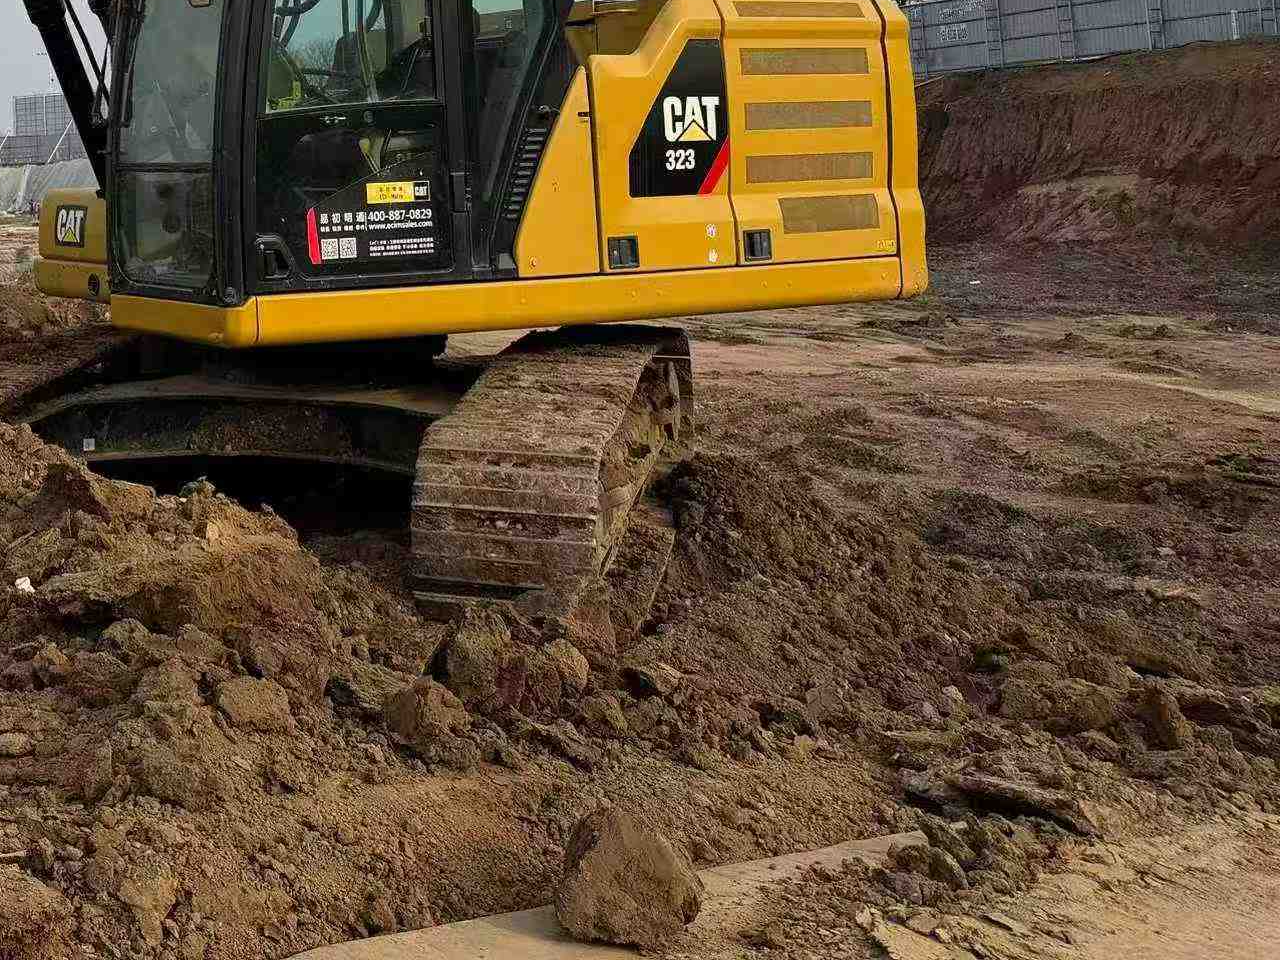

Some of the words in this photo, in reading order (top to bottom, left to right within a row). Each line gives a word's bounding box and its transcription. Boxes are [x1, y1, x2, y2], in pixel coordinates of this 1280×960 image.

[663, 96, 720, 142] CAT
[665, 149, 696, 171] 323
[57, 208, 84, 243] CAT
[367, 209, 432, 222] 400-887-0829
